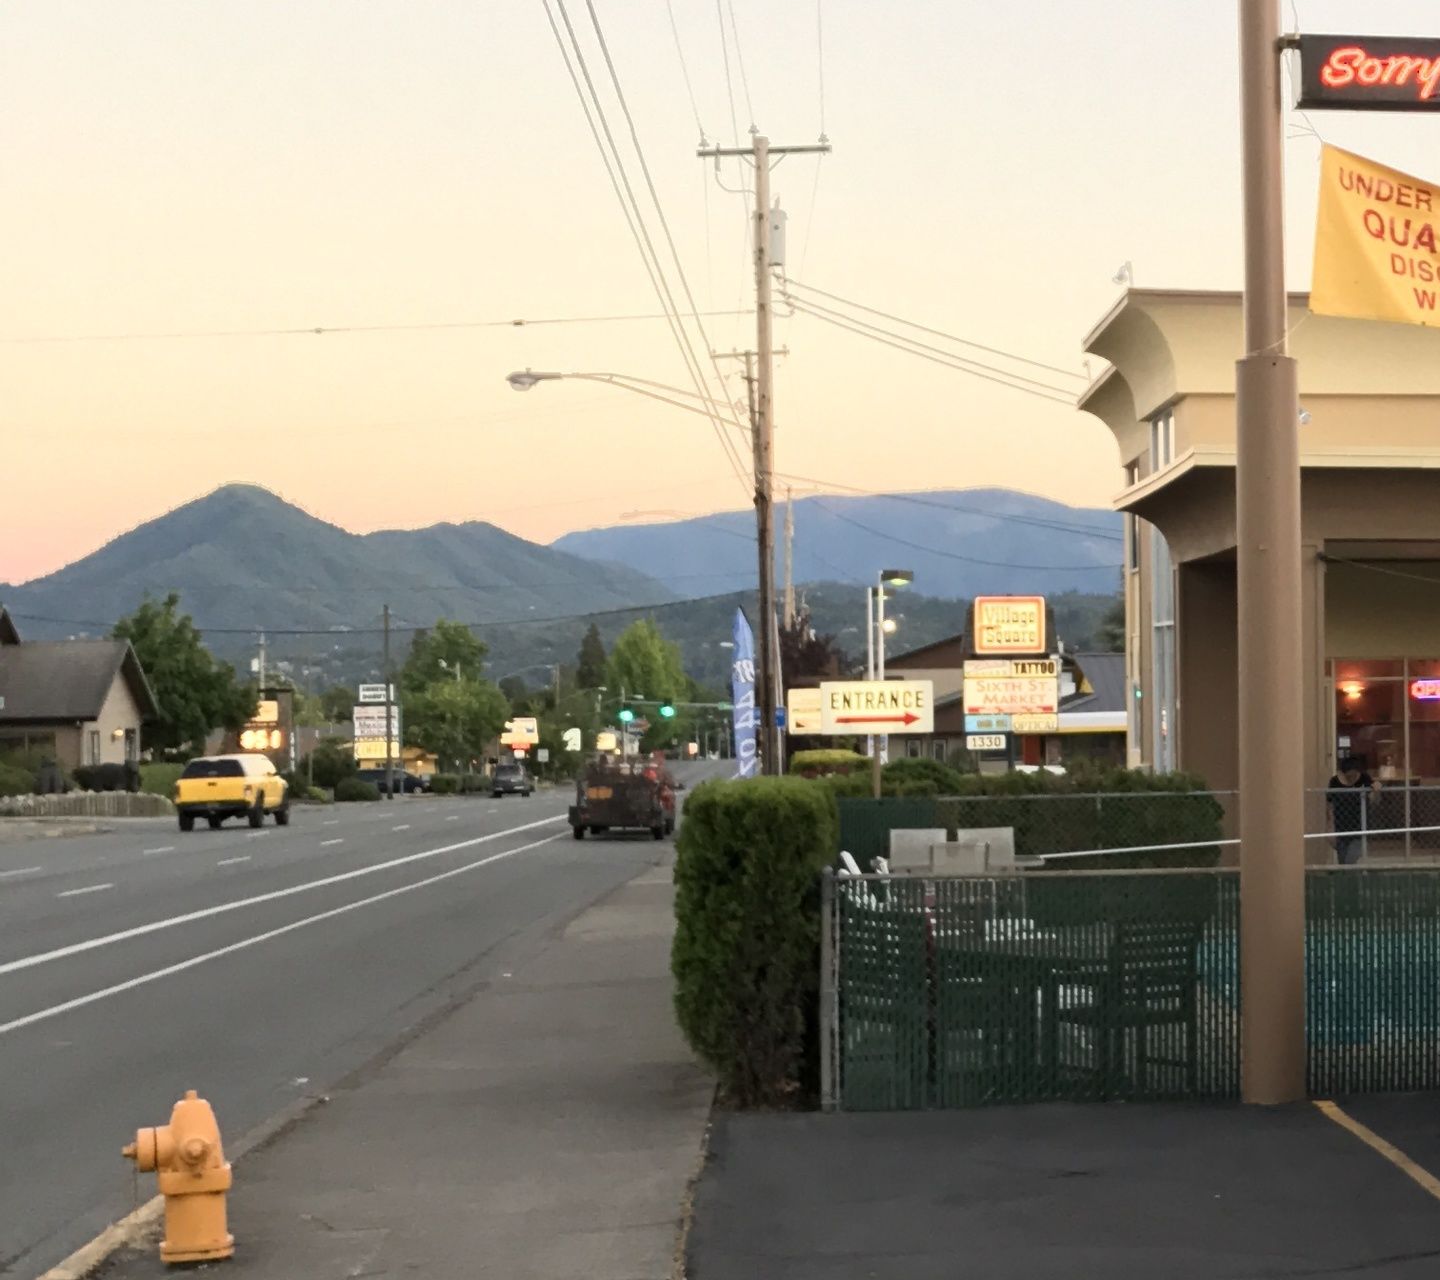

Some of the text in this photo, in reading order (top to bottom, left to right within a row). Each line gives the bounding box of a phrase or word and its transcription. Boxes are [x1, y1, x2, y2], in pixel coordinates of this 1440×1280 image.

[1338, 167, 1432, 212] UNDER
[984, 606, 1035, 627] Village
[986, 630, 1035, 644] Square
[1014, 662, 1055, 674] TATTOO
[831, 690, 924, 709] ENTRANCE
[983, 694, 1047, 705] MARKET
[972, 737, 1001, 747] 1330
